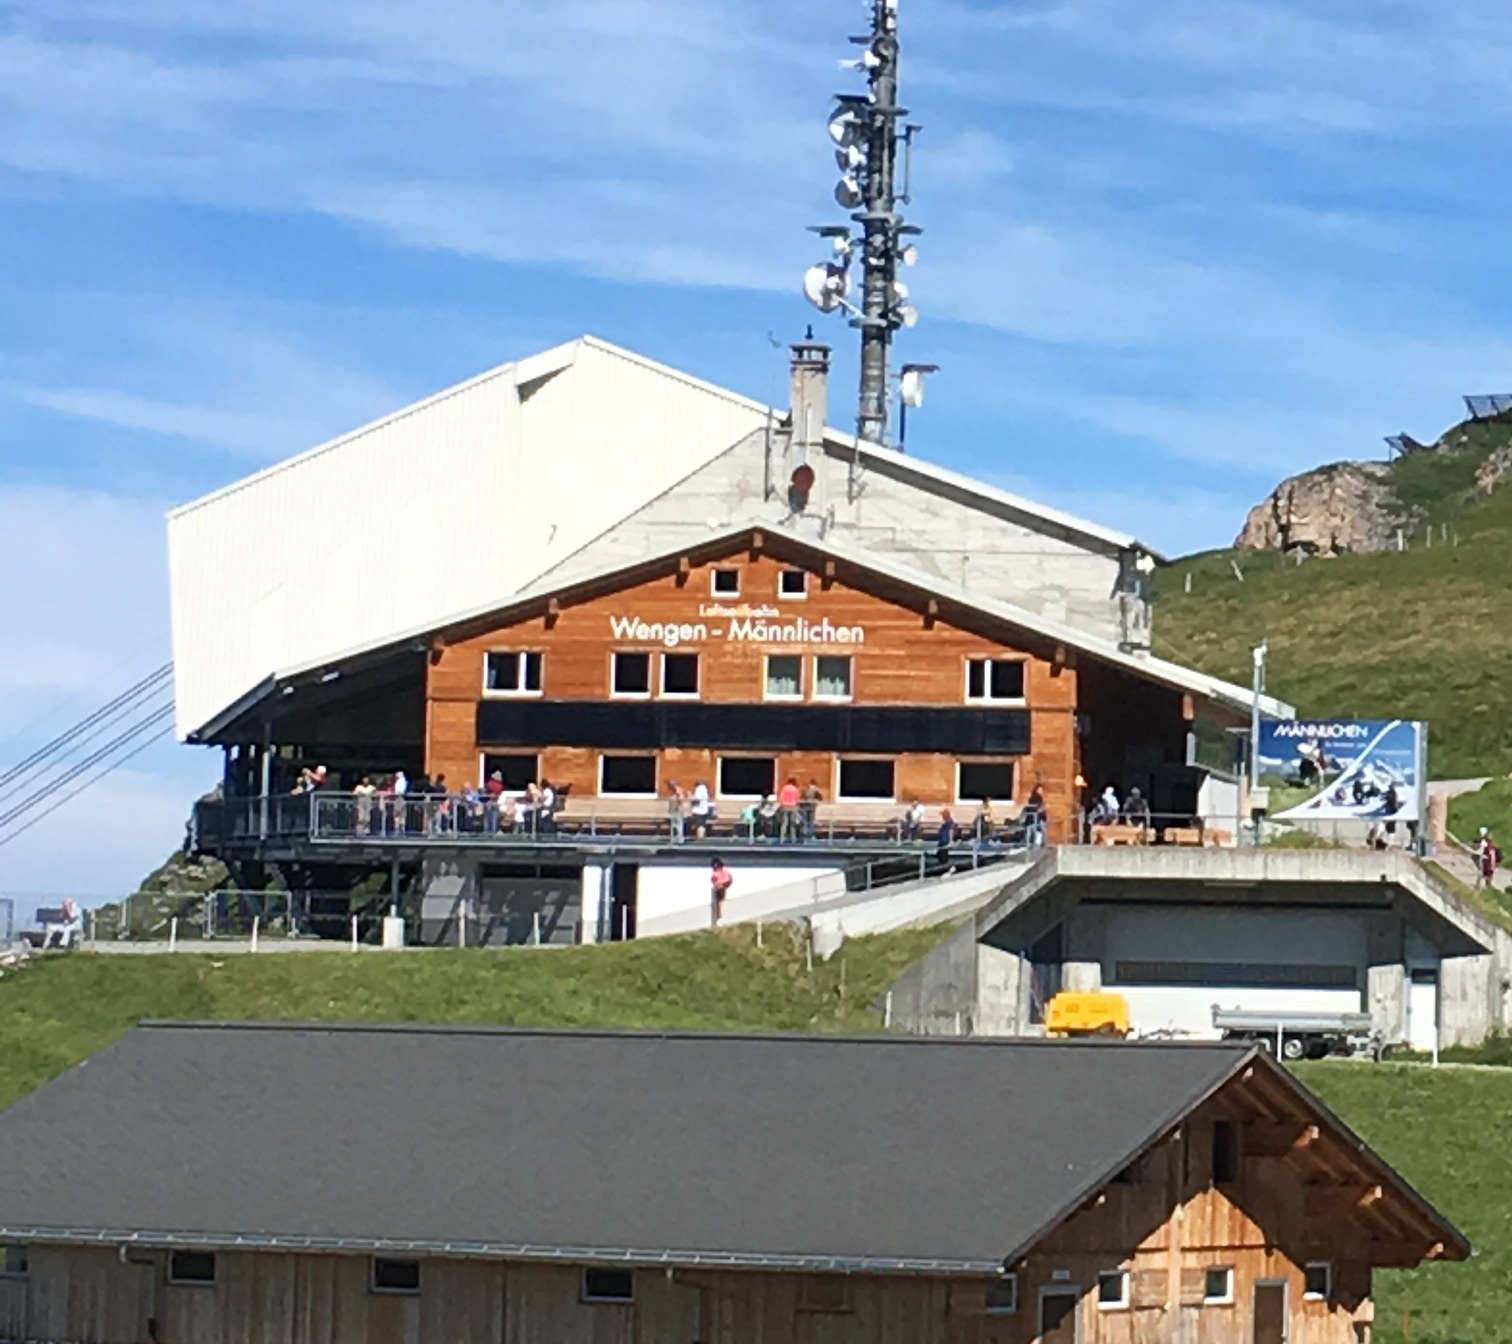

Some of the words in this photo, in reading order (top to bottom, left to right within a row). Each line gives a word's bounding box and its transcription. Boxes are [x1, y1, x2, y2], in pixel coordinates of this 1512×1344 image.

[610, 616, 706, 646] Wengen
[728, 618, 865, 643] Männlichen
[1273, 721, 1368, 738] MÄNNLICHEN
